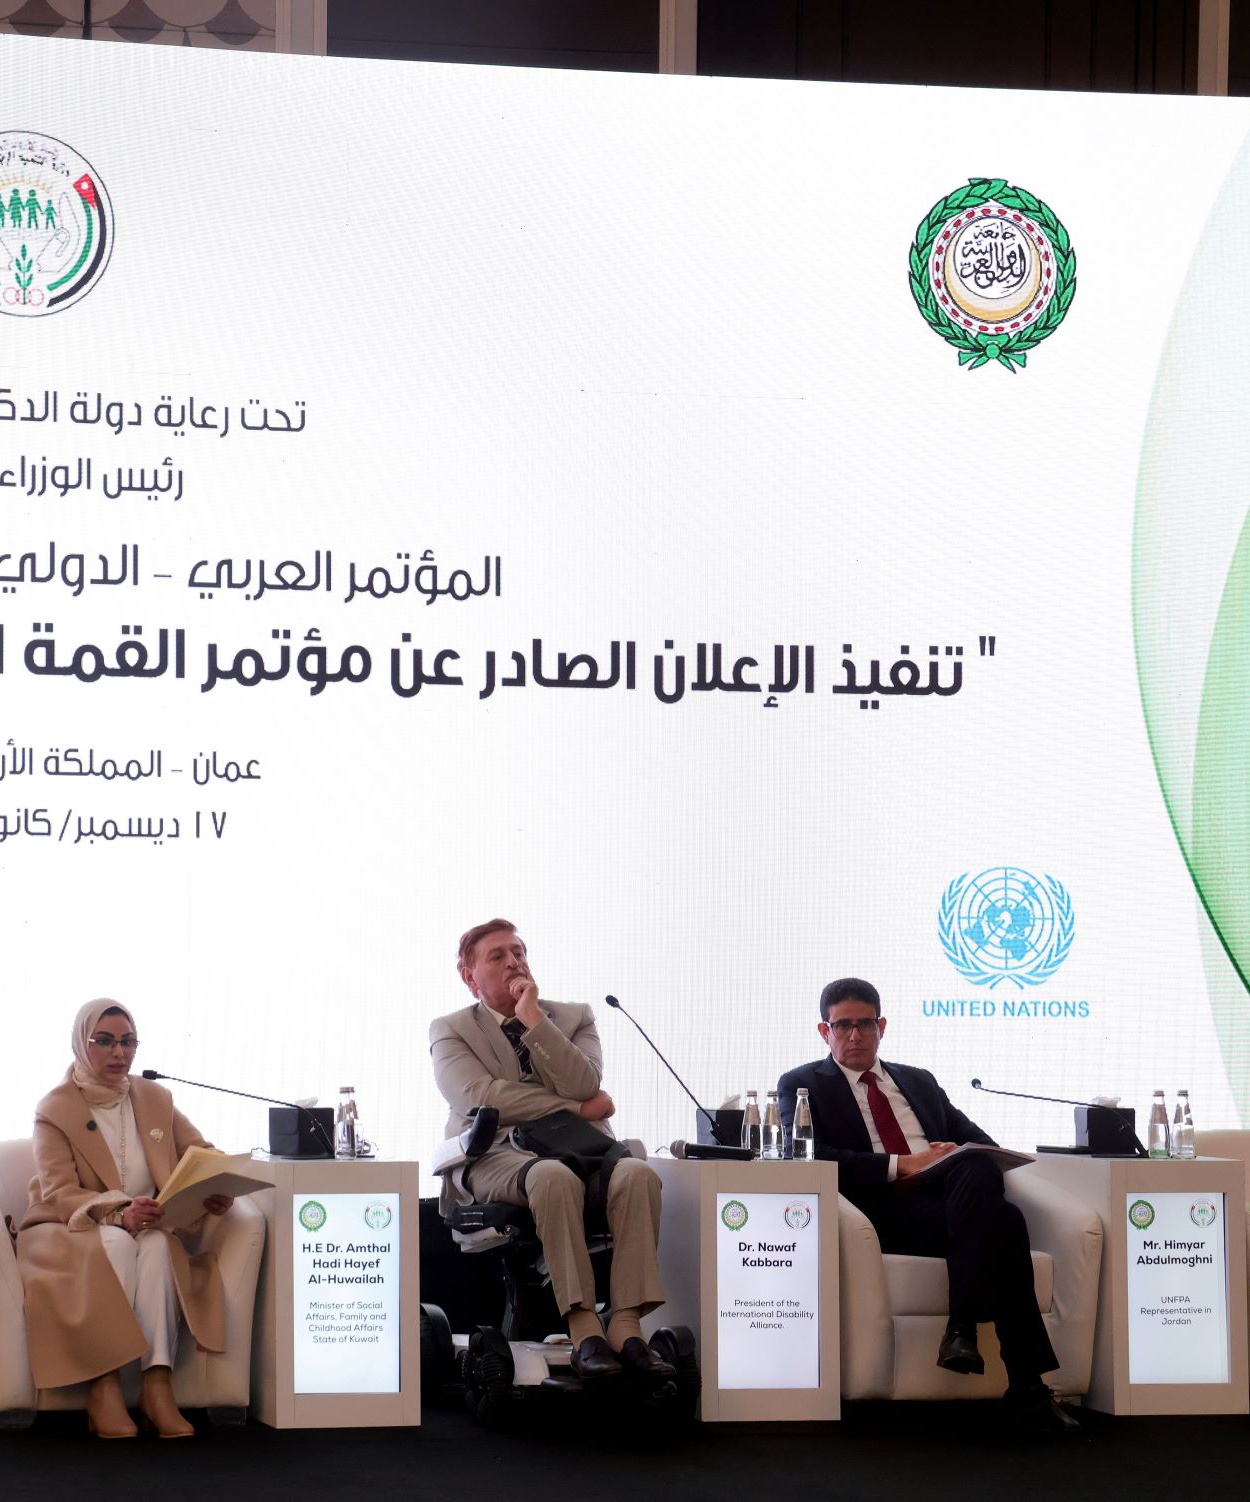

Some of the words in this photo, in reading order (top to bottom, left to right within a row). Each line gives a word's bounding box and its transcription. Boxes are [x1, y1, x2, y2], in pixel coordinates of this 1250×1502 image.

[70, 392, 141, 435] دولة
[154, 396, 228, 438] رعاية
[241, 399, 305, 432] تحت
[103, 457, 182, 501] رئيس
[188, 550, 331, 600] العربي
[345, 550, 500, 605] المؤتمر
[24, 623, 185, 682] القمة
[201, 628, 372, 696] مؤتمر
[391, 633, 463, 698] عن
[480, 639, 635, 699] الصادر
[654, 640, 814, 707] الإعلان
[833, 644, 963, 709] تنفيذ
[44, 748, 161, 781] المملكة
[194, 751, 261, 785] عمان
[922, 999, 997, 1017] UNITED
[1002, 1000, 1090, 1018] NATIONS
[302, 1243, 323, 1253] H.E
[326, 1243, 343, 1253] Dr.
[346, 1243, 391, 1253] Amthal
[738, 1242, 755, 1252] Dr.
[758, 1242, 797, 1252] Nawaf
[1143, 1240, 1161, 1250] Mr.
[1164, 1240, 1206, 1251] Himyar
[312, 1258, 341, 1269] Hadi
[344, 1258, 381, 1271] Hayef
[742, 1257, 793, 1267] Kabbara
[1136, 1254, 1213, 1268] Abdulmoghni
[308, 1274, 384, 1284] Al-Huwailah
[309, 1301, 344, 1310] Minister
[346, 1301, 355, 1310] of
[357, 1301, 383, 1310] Social
[734, 1299, 774, 1308] President
[776, 1299, 785, 1307] of
[1161, 1296, 1191, 1304] UNFPA
[339, 1312, 368, 1322] Family
[369, 1312, 387, 1321] and
[720, 1310, 774, 1319] International
[776, 1310, 815, 1320] Disability
[1140, 1306, 1203, 1317] Representative
[1204, 1306, 1211, 1314] in
[308, 1323, 352, 1332] Childhood
[353, 1323, 384, 1332] Affairs
[1161, 1317, 1192, 1326] Jordan
[312, 1335, 337, 1344] State
[338, 1335, 348, 1344] of
[349, 1335, 379, 1343] Kuwait
